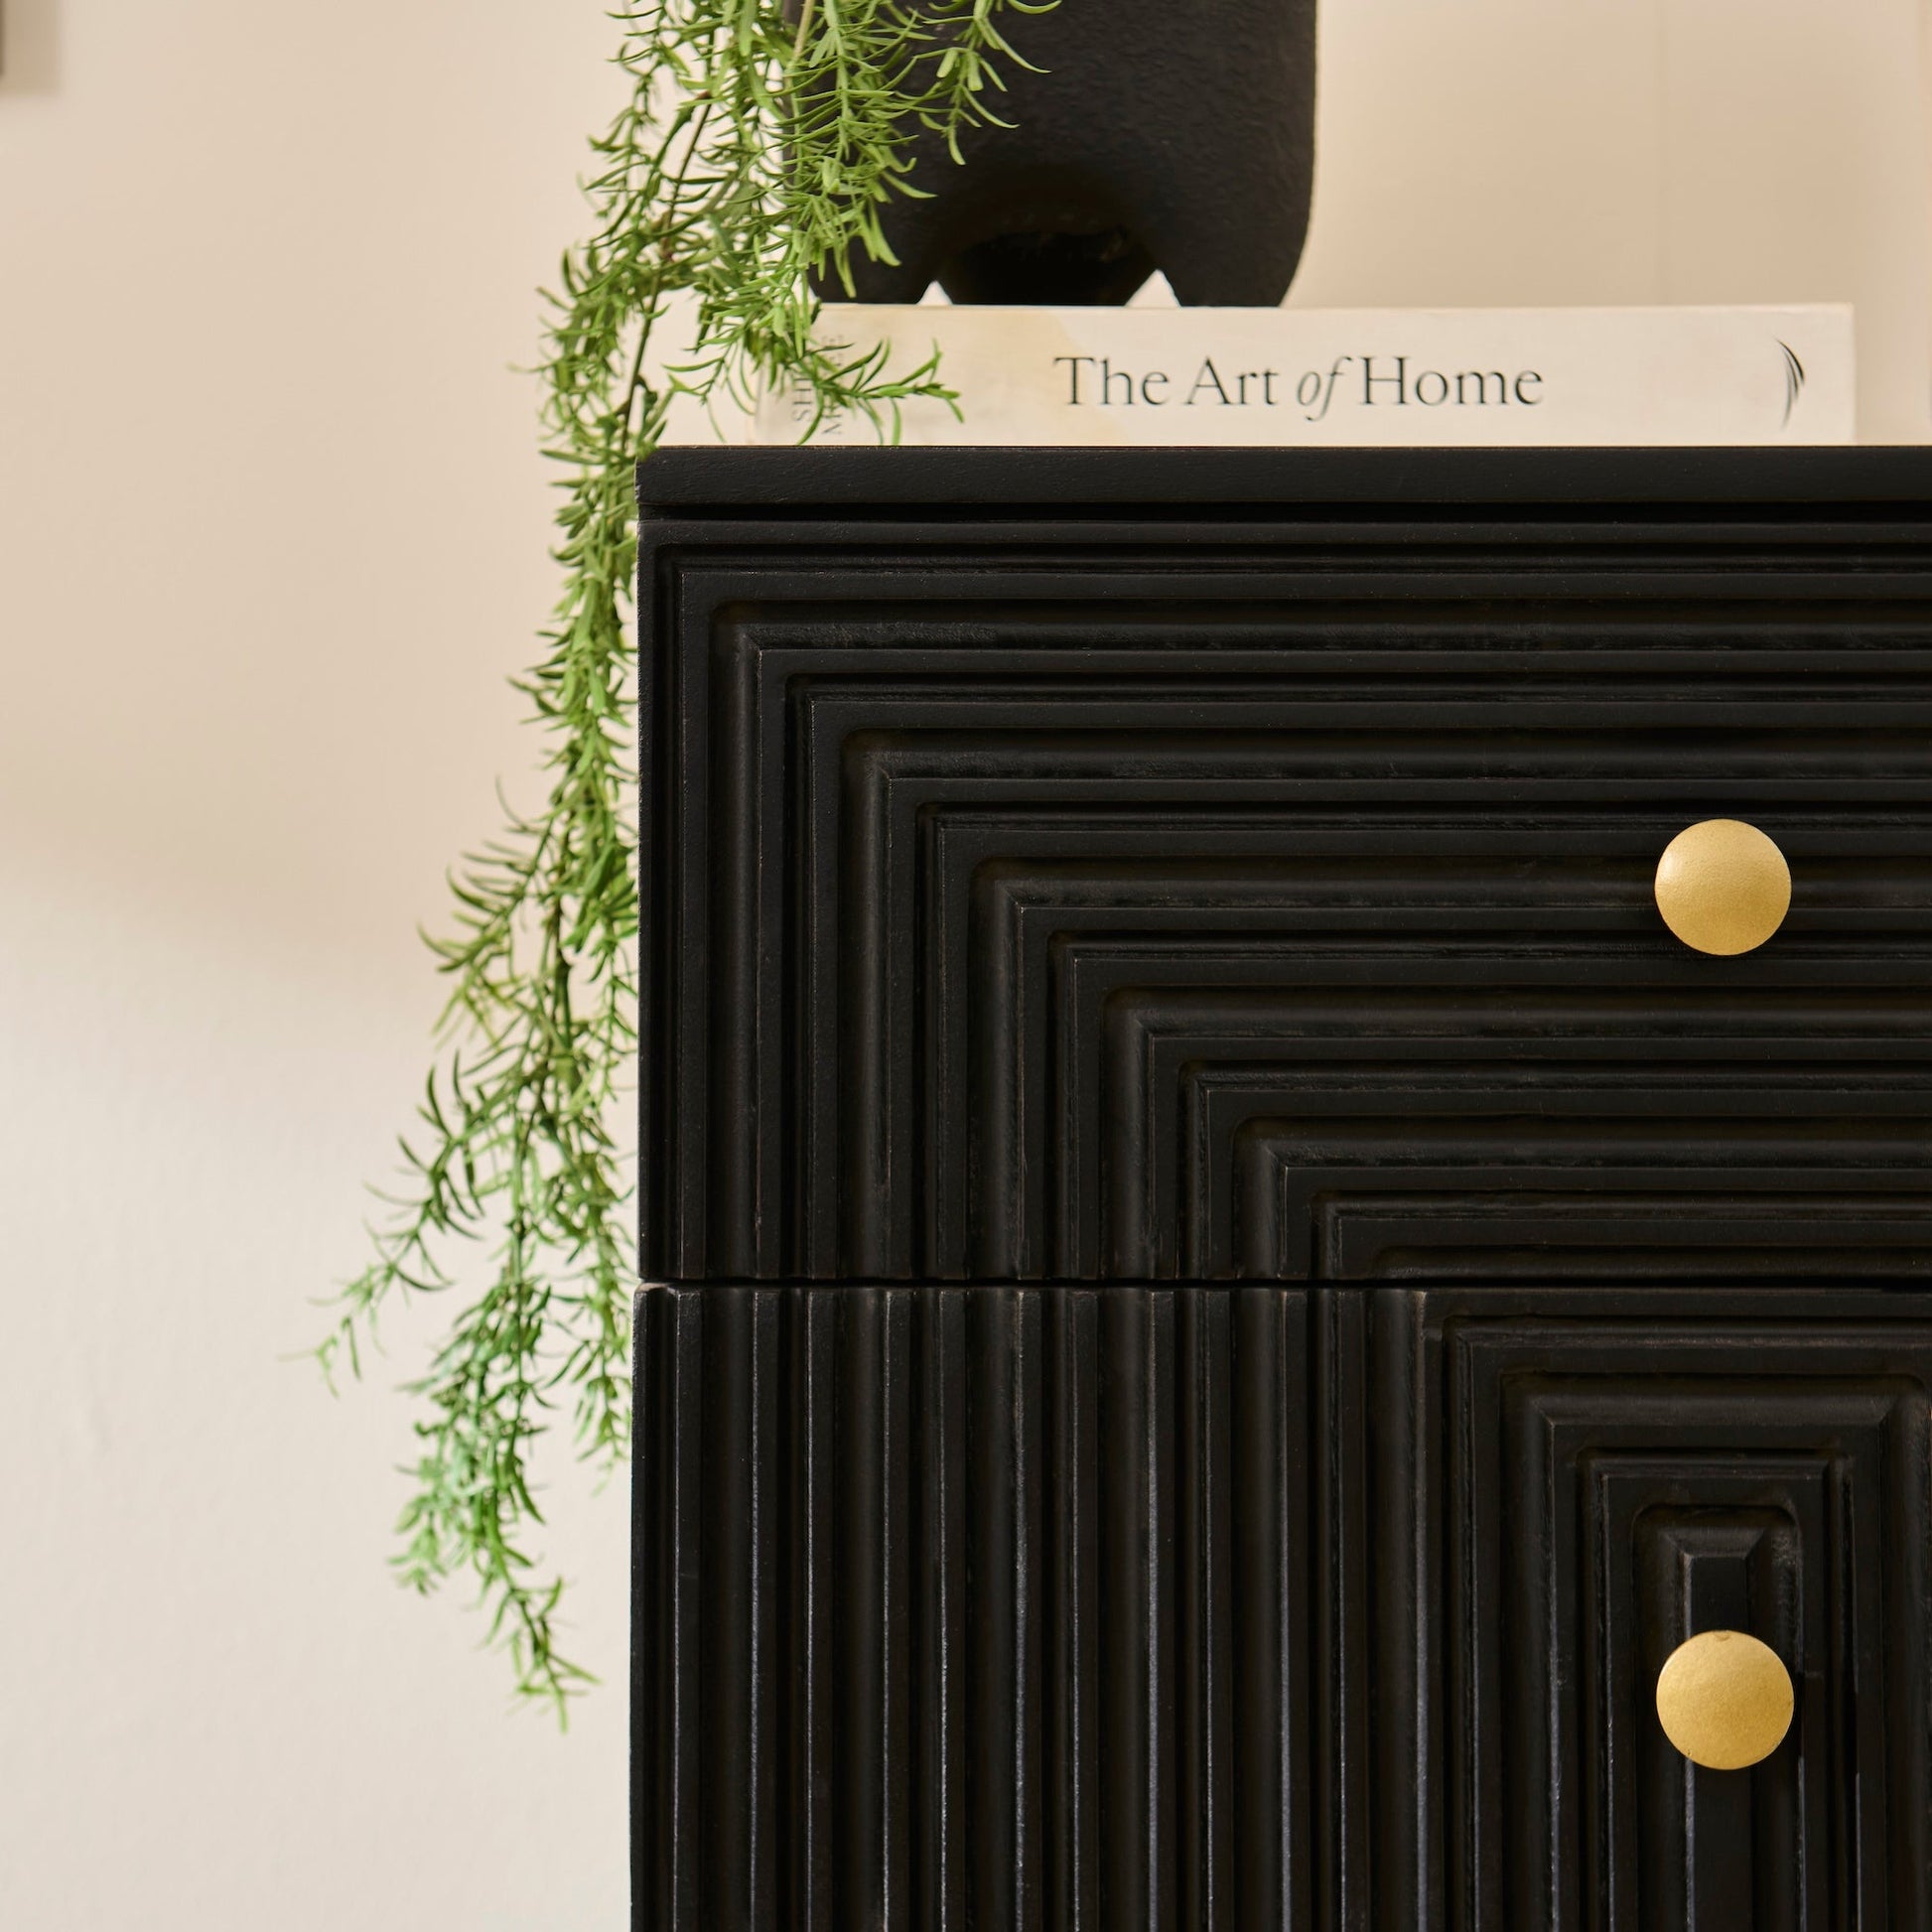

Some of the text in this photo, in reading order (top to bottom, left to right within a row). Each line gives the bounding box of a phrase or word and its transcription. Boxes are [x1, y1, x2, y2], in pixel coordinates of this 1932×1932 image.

[1053, 356, 1544, 421] The Art of Home
